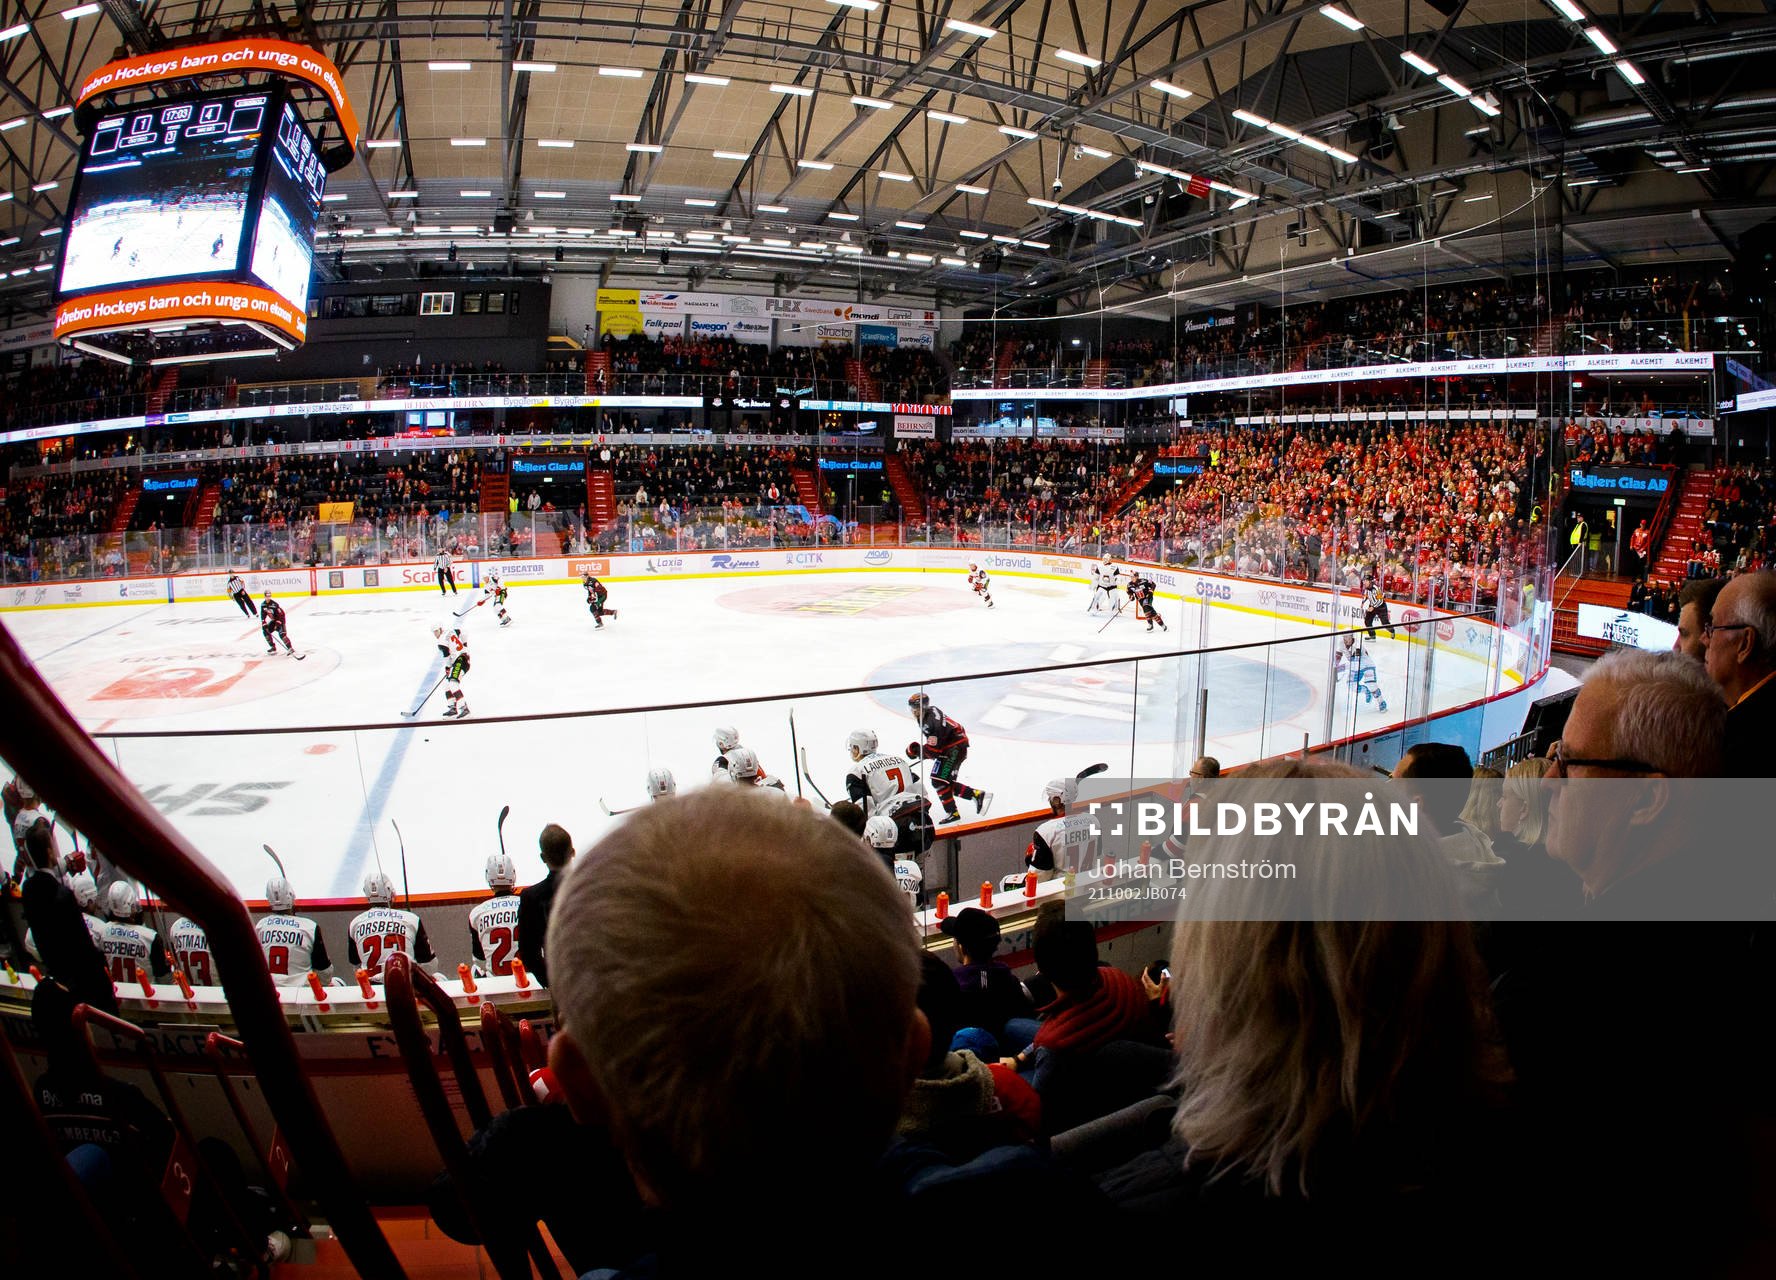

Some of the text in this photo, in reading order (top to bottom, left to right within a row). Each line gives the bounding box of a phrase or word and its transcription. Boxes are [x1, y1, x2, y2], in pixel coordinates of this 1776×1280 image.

[115, 61, 178, 81] Hockeys
[181, 55, 218, 68] barn
[221, 48, 254, 62] och
[258, 51, 297, 65] unga
[301, 59, 322, 75] om
[165, 108, 189, 121] 17:03
[93, 298, 146, 318] Hockeys
[149, 295, 180, 310] barn
[183, 291, 211, 306] och
[215, 295, 247, 309] unga
[251, 298, 268, 312] om
[766, 299, 801, 313] FLEX
[645, 319, 683, 330] Folkpool
[692, 321, 728, 332] Swegon
[1468, 363, 1494, 371] ALKEMIT
[1506, 361, 1534, 369] ALKEMIT
[1546, 360, 1575, 368] ALKEMIT
[1588, 358, 1618, 366] ALKEMIT
[1631, 358, 1663, 366] ALKEMIT
[1675, 356, 1708, 366] ALKEMIT
[897, 422, 924, 431] BEHRN
[548, 462, 566, 471] Glas
[569, 461, 584, 470] AB
[869, 461, 882, 469] AB
[1619, 476, 1646, 489] Glas
[1647, 479, 1668, 491] AB
[576, 562, 603, 572] renta
[995, 556, 1032, 568] bravida
[502, 564, 544, 573] PISCATOR
[261, 577, 302, 586] VENTILATION
[1155, 574, 1176, 586] TEGEL
[1196, 578, 1232, 600] ÖBAB
[1316, 601, 1330, 613] DET
[1603, 622, 1639, 637] INTEROC
[1602, 631, 1639, 646] AKUSTIK
[885, 767, 905, 794] 7
[266, 917, 300, 928] bravida
[173, 1162, 191, 1196] 3
